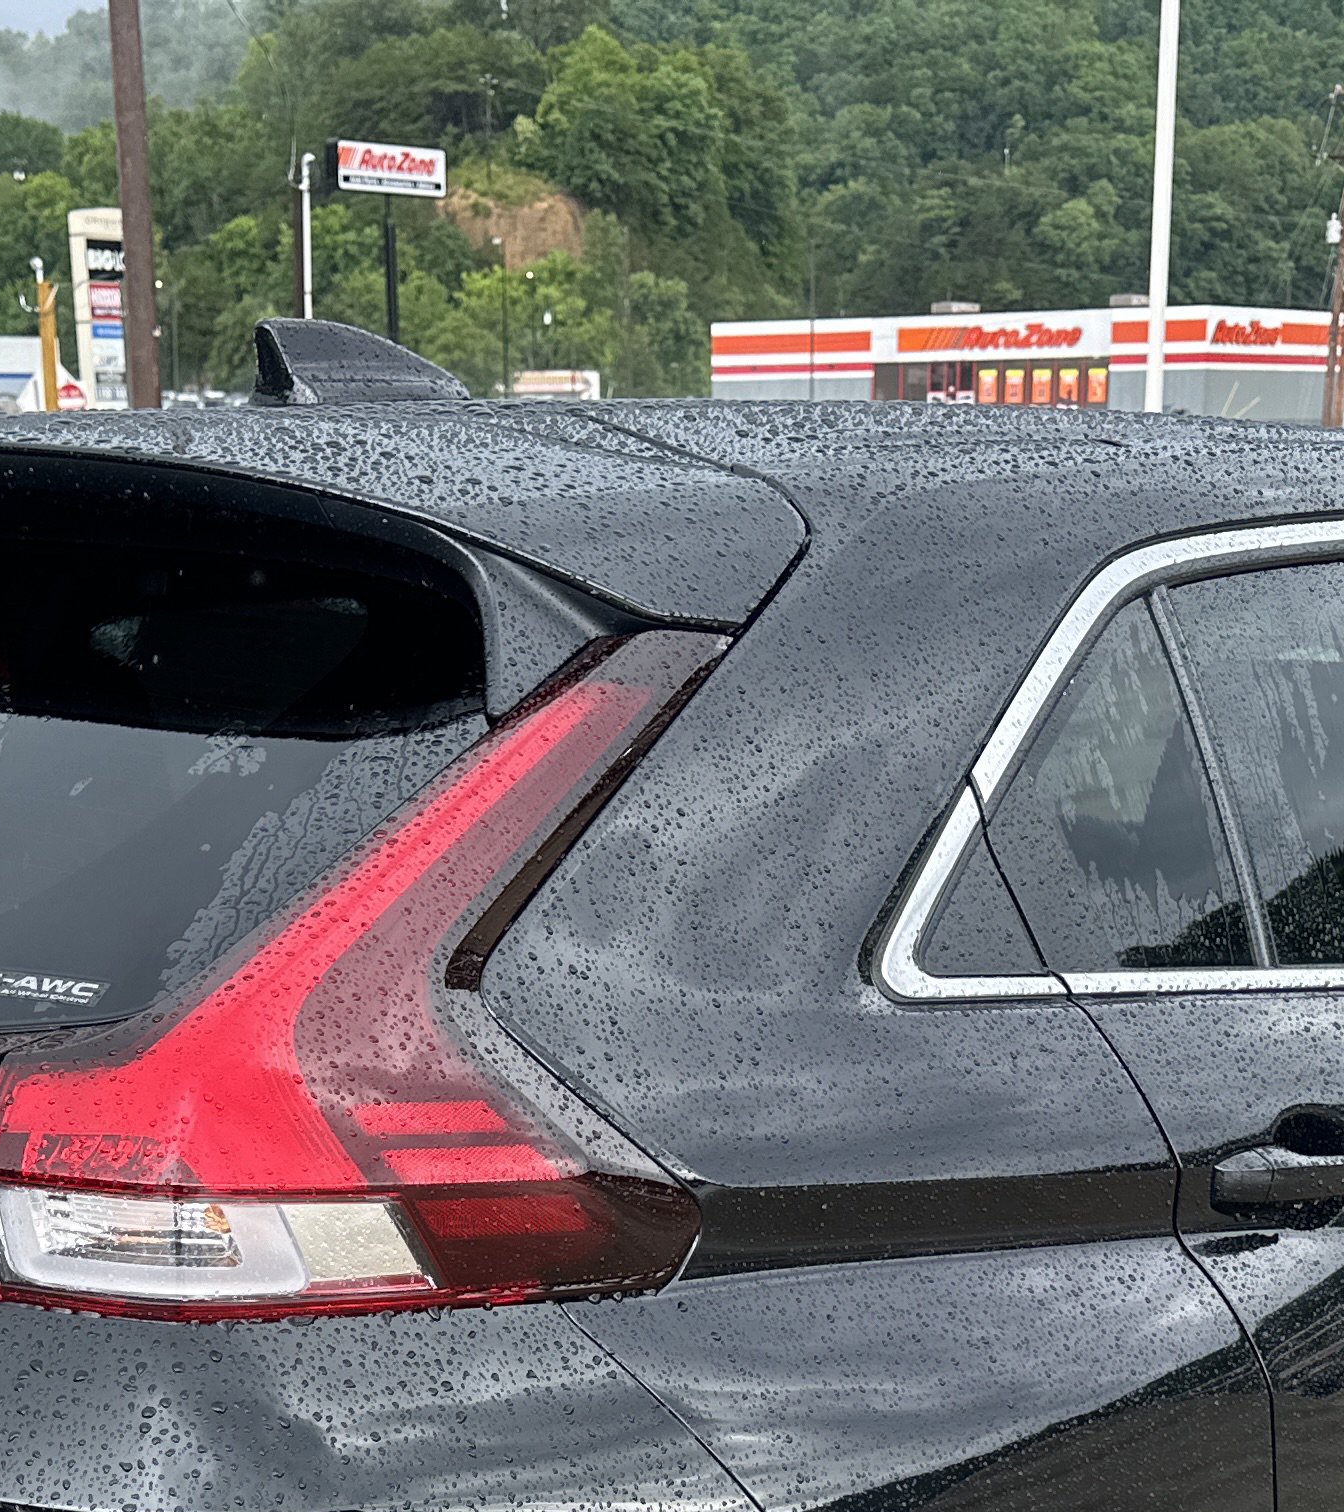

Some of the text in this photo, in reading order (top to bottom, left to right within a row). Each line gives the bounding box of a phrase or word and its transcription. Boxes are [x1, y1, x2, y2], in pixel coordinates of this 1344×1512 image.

[359, 148, 436, 177] AutoZone
[959, 322, 1083, 350] AutoZone
[1210, 319, 1280, 346] AutoZone
